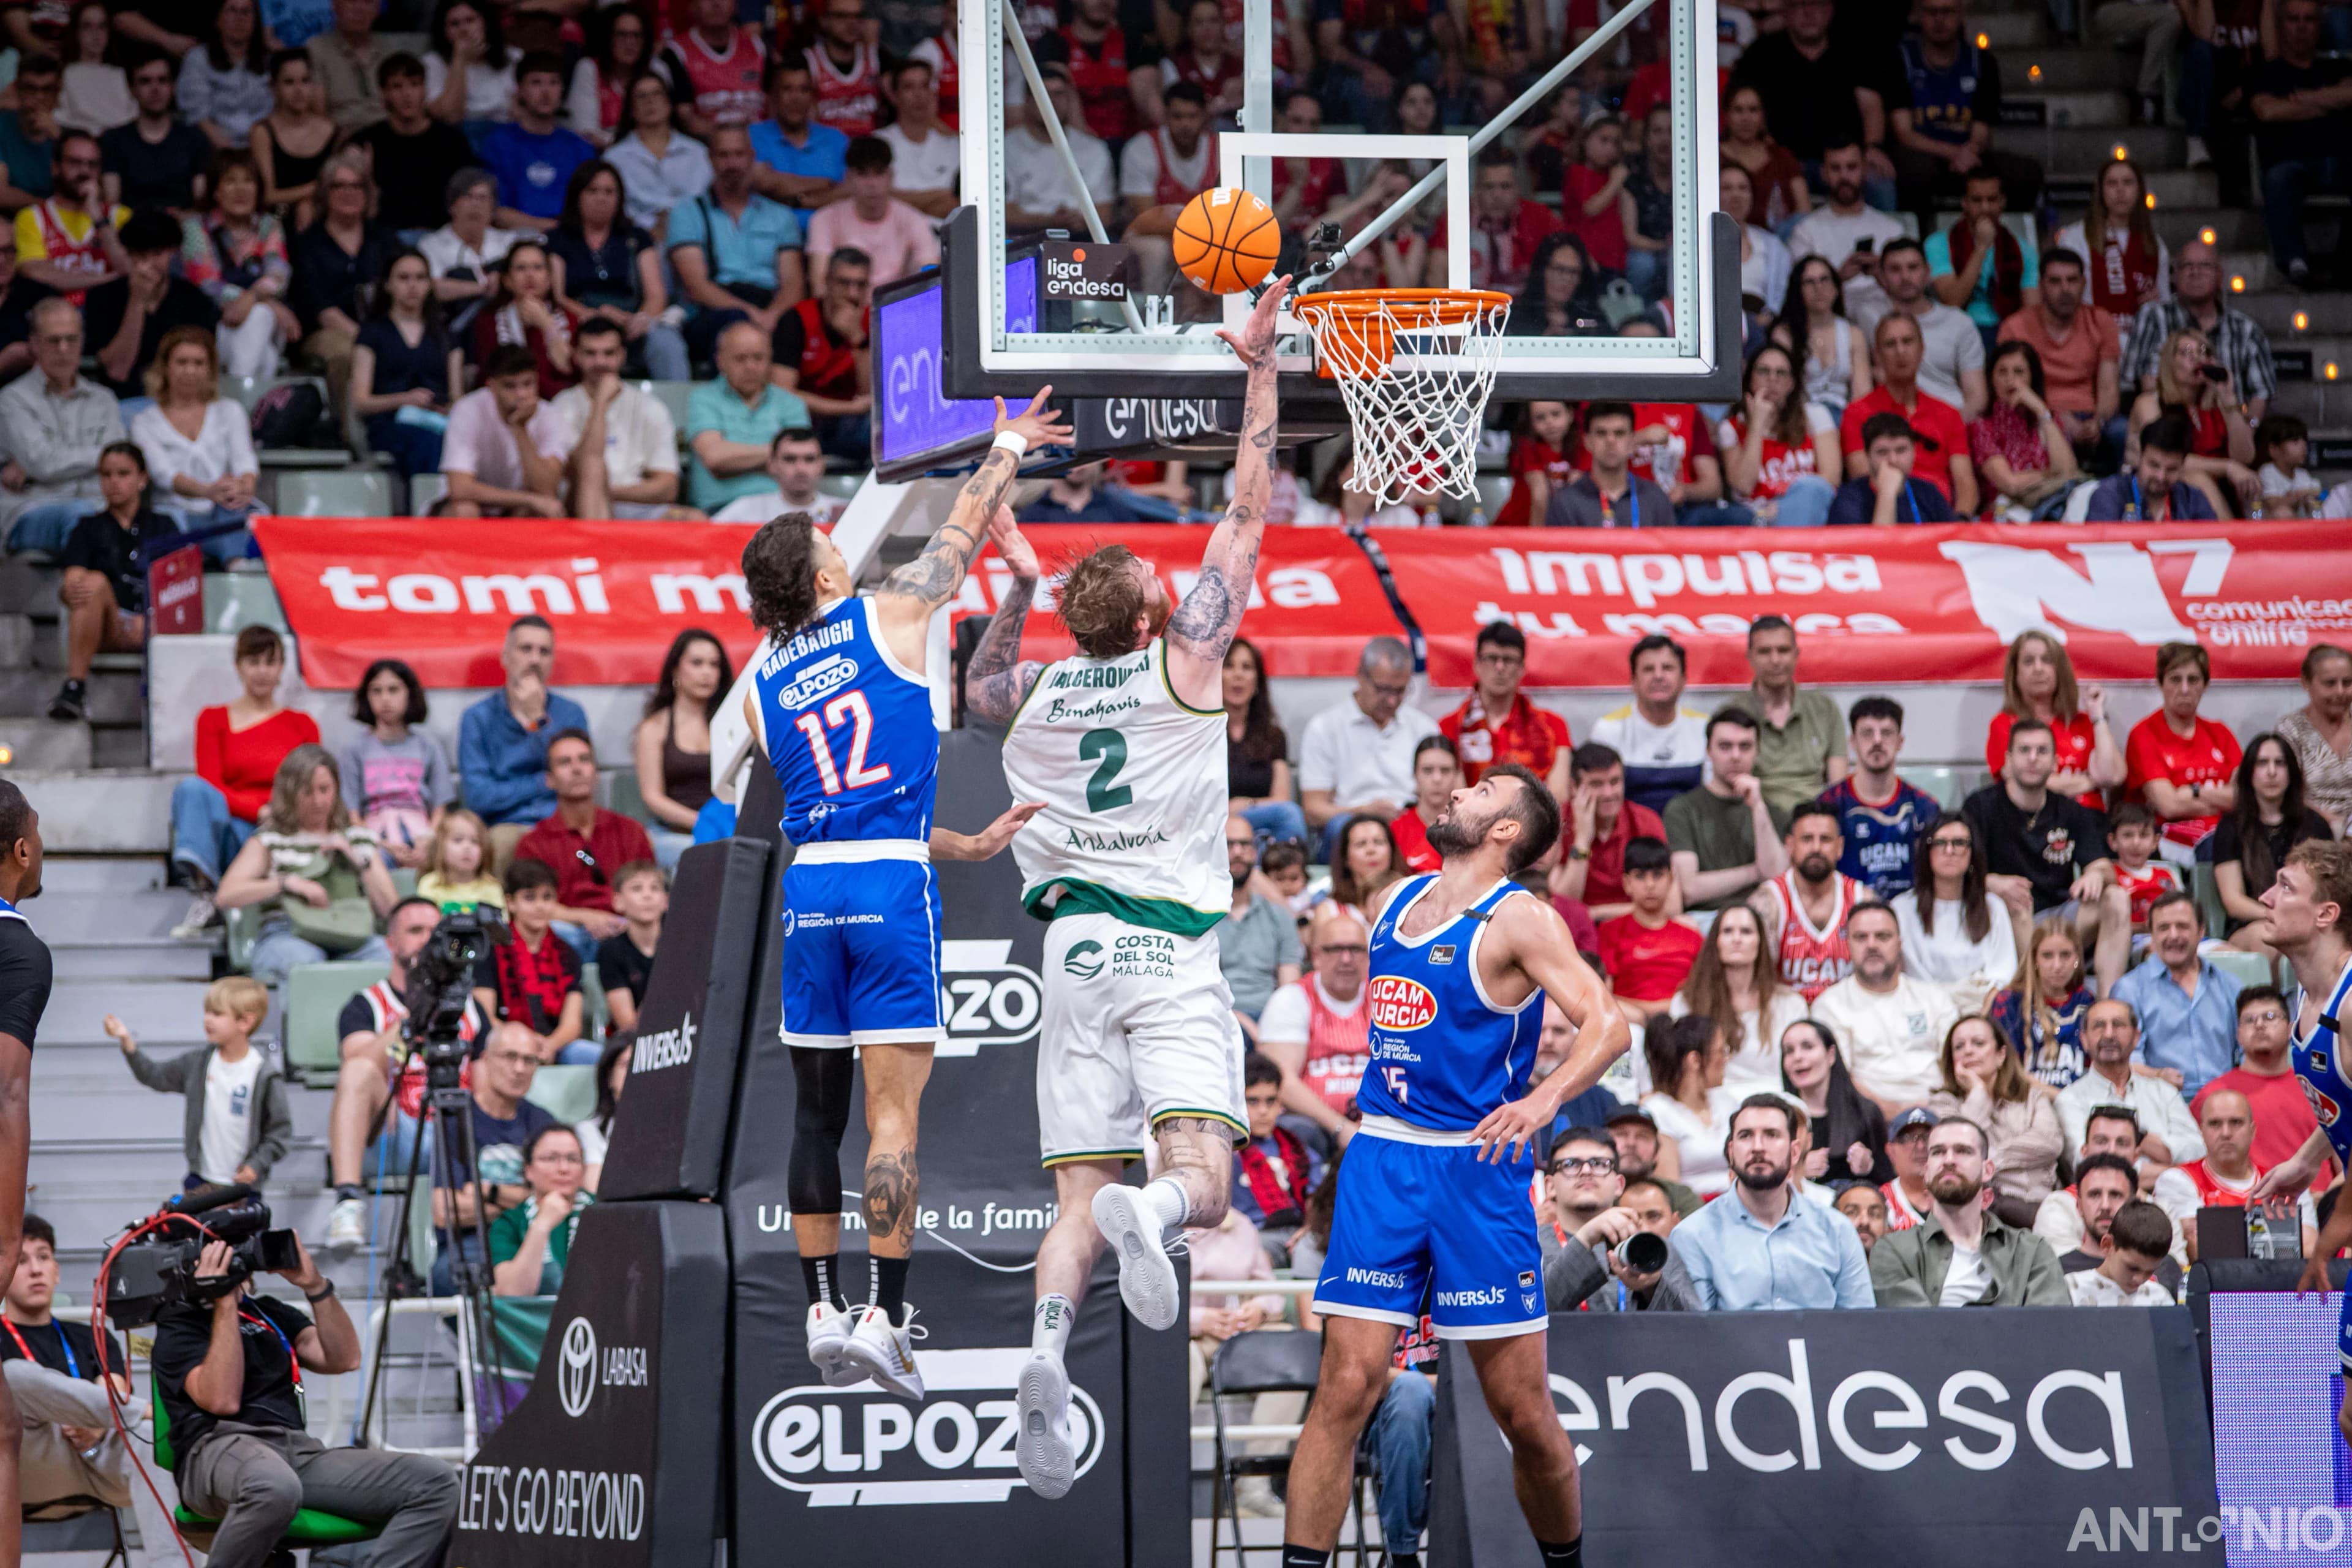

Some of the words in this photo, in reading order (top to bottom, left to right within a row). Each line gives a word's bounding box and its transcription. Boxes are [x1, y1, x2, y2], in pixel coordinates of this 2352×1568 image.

[1047, 257, 1082, 279] liga
[1047, 277, 1124, 296] endesa
[320, 557, 610, 613] tomi
[761, 619, 854, 681] RADEBAUGH
[794, 689, 892, 796] 12
[1079, 728, 1133, 813] 2
[1063, 824, 1170, 852] Andalucía
[1859, 842, 1910, 867] UCAM
[798, 919, 834, 928] REGIÓN
[835, 916, 846, 925] DE
[847, 914, 884, 924] MURCIA
[1115, 935, 1175, 951] COSTA
[1114, 951, 1141, 963] DEL
[1146, 951, 1174, 965] SOL
[1783, 957, 1853, 982] UCAM
[1112, 963, 1174, 979] MÁLAGA
[1373, 979, 1424, 1006] UCAM
[1383, 1043, 1410, 1053] REGIÓN
[1392, 1052, 1421, 1062] MURCIA
[949, 1205, 973, 1229] la
[1044, 1301, 1063, 1330] UNICAJA
[602, 1347, 647, 1386] LABASA
[458, 1466, 511, 1531] LET'S
[513, 1466, 550, 1535] GO
[552, 1469, 644, 1540] BEYOND
